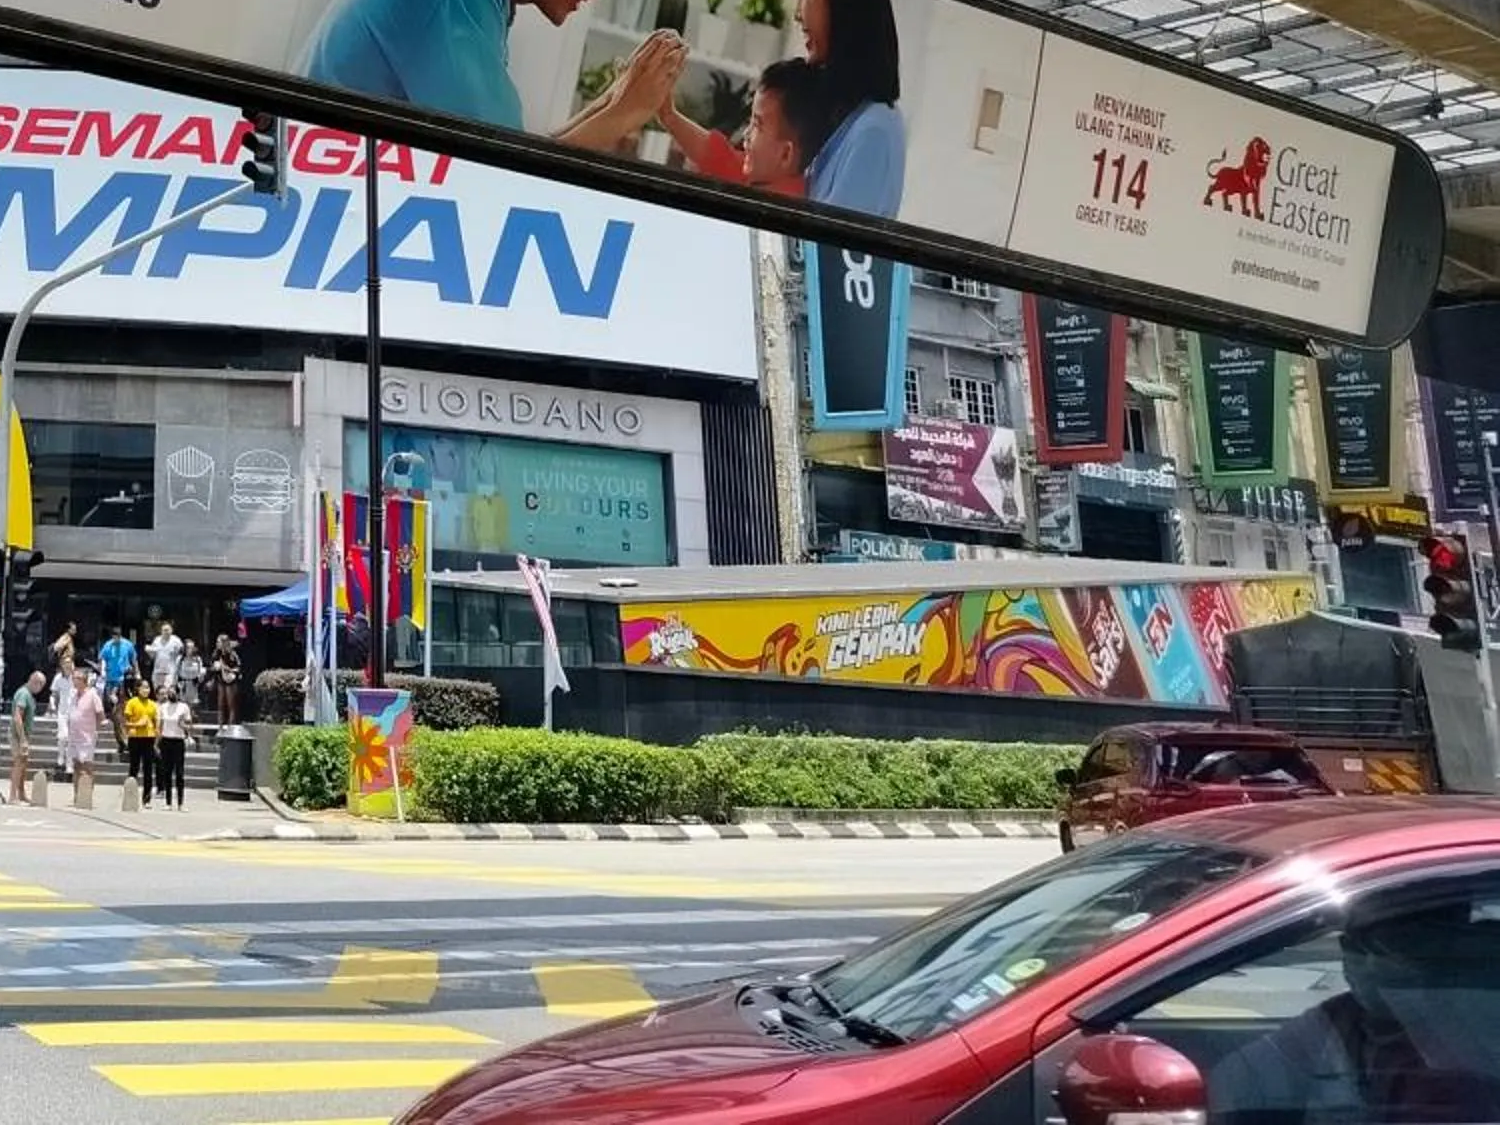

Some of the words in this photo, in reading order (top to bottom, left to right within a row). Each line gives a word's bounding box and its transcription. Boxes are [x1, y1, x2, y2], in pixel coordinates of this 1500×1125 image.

[1075, 111, 1113, 139] ULANG
[1117, 124, 1154, 151] TAHUN
[1156, 136, 1176, 155] KE-
[1094, 93, 1167, 131] MENYAMBUT
[1092, 148, 1149, 210] 114
[1276, 146, 1340, 200] Great
[1076, 204, 1111, 227] GREAT
[1114, 214, 1148, 237] YEARS
[1268, 187, 1351, 245] Eastern
[380, 378, 643, 436] GIORDANO
[1242, 486, 1306, 511] PULSE
[826, 622, 927, 671] GEMPAK
